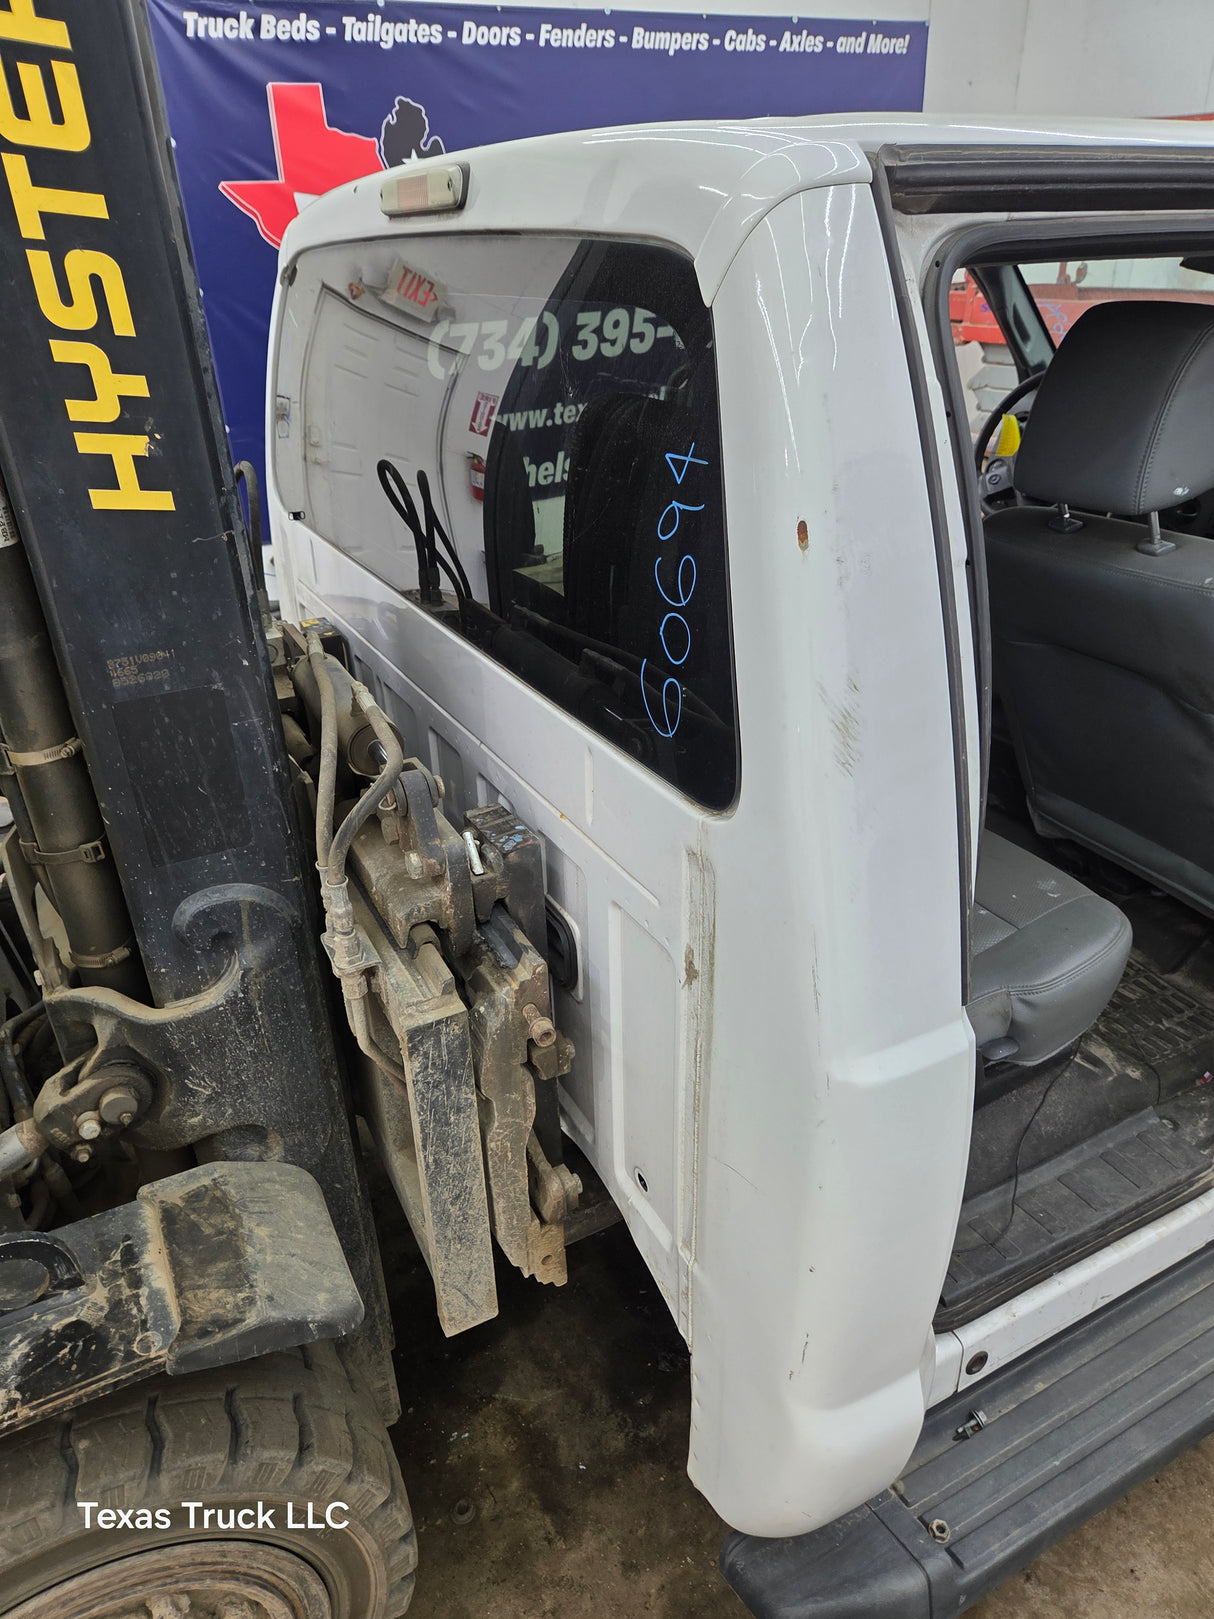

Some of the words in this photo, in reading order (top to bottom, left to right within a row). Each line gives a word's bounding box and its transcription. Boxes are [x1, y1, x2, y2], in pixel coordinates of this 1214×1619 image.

[182, 11, 255, 39] Truck
[259, 13, 321, 41] Beds
[342, 14, 443, 49] Tailgates
[461, 21, 522, 46] Doors
[538, 23, 616, 48] Fenders
[631, 26, 710, 56] Bumpers
[724, 29, 767, 52] Cabs
[778, 29, 824, 53] Axles
[836, 32, 866, 54] and
[866, 34, 910, 54] More!
[426, 311, 559, 380] (734)
[572, 307, 674, 362] 395-
[641, 443, 708, 738] 60694
